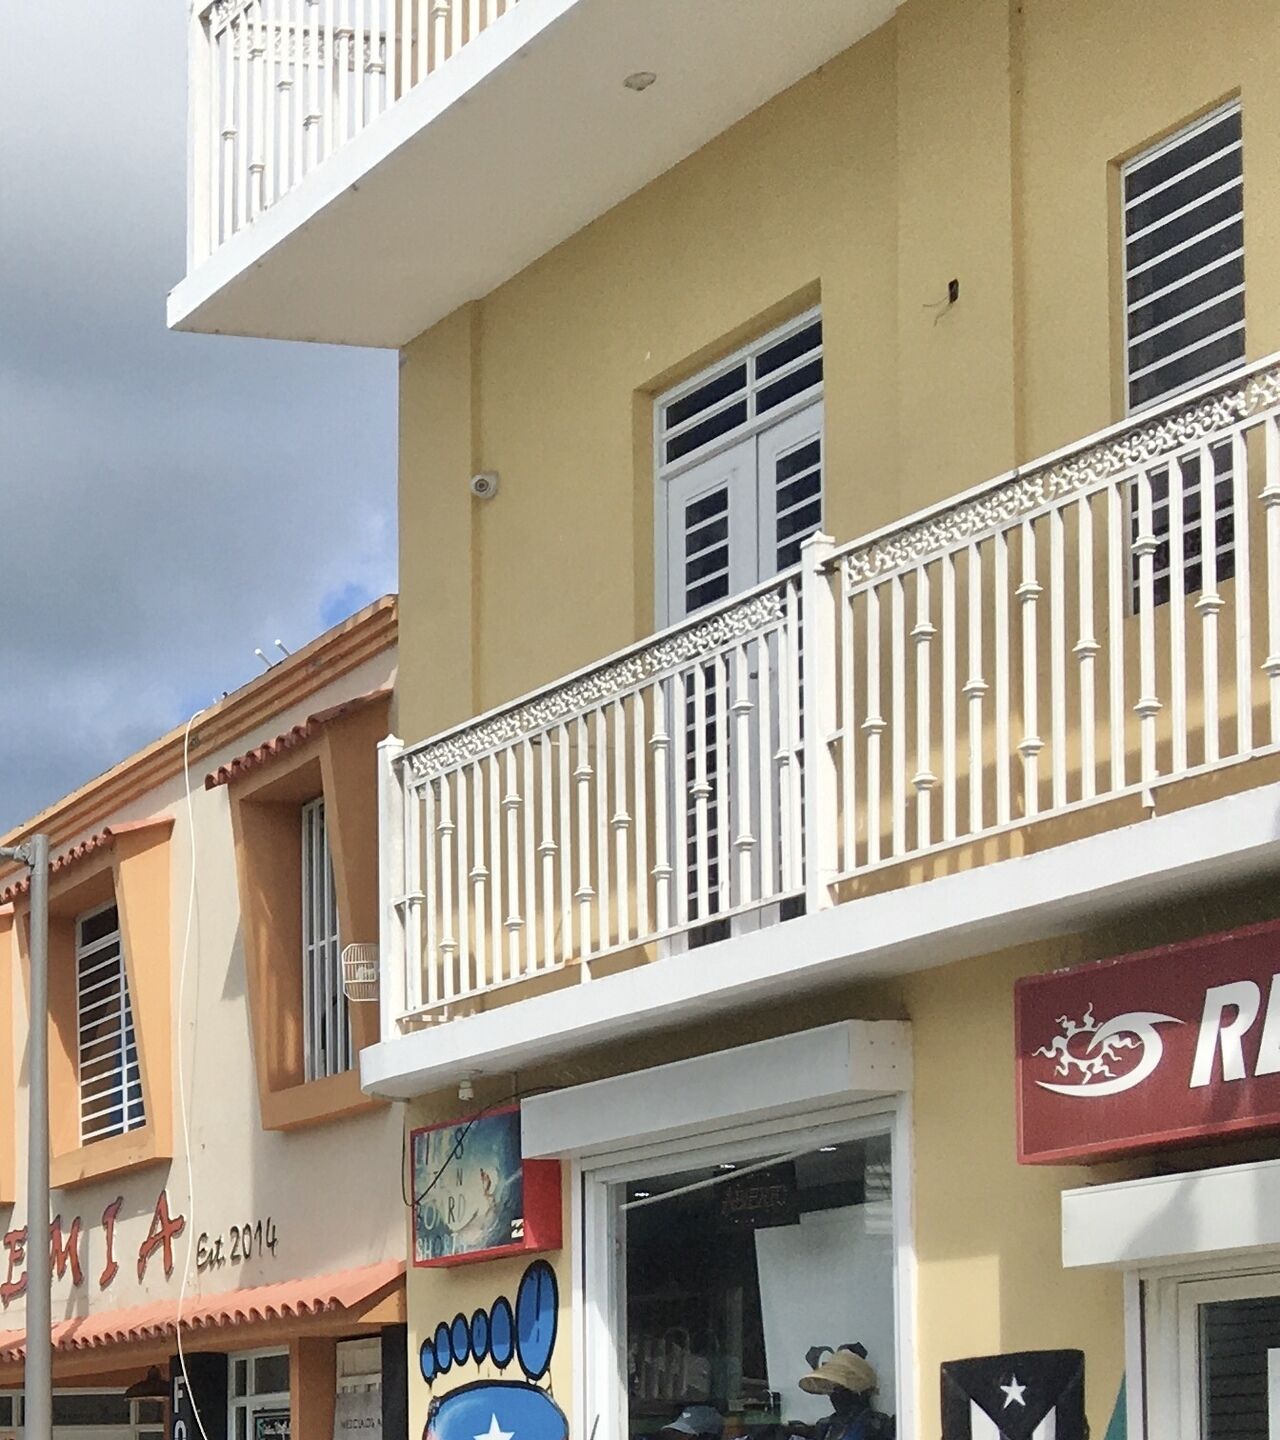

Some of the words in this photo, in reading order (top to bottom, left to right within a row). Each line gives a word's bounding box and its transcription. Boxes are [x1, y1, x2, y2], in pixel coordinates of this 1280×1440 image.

[1189, 973, 1280, 1089] R
[196, 1232, 225, 1268] Est.
[229, 1217, 278, 1261] 2014
